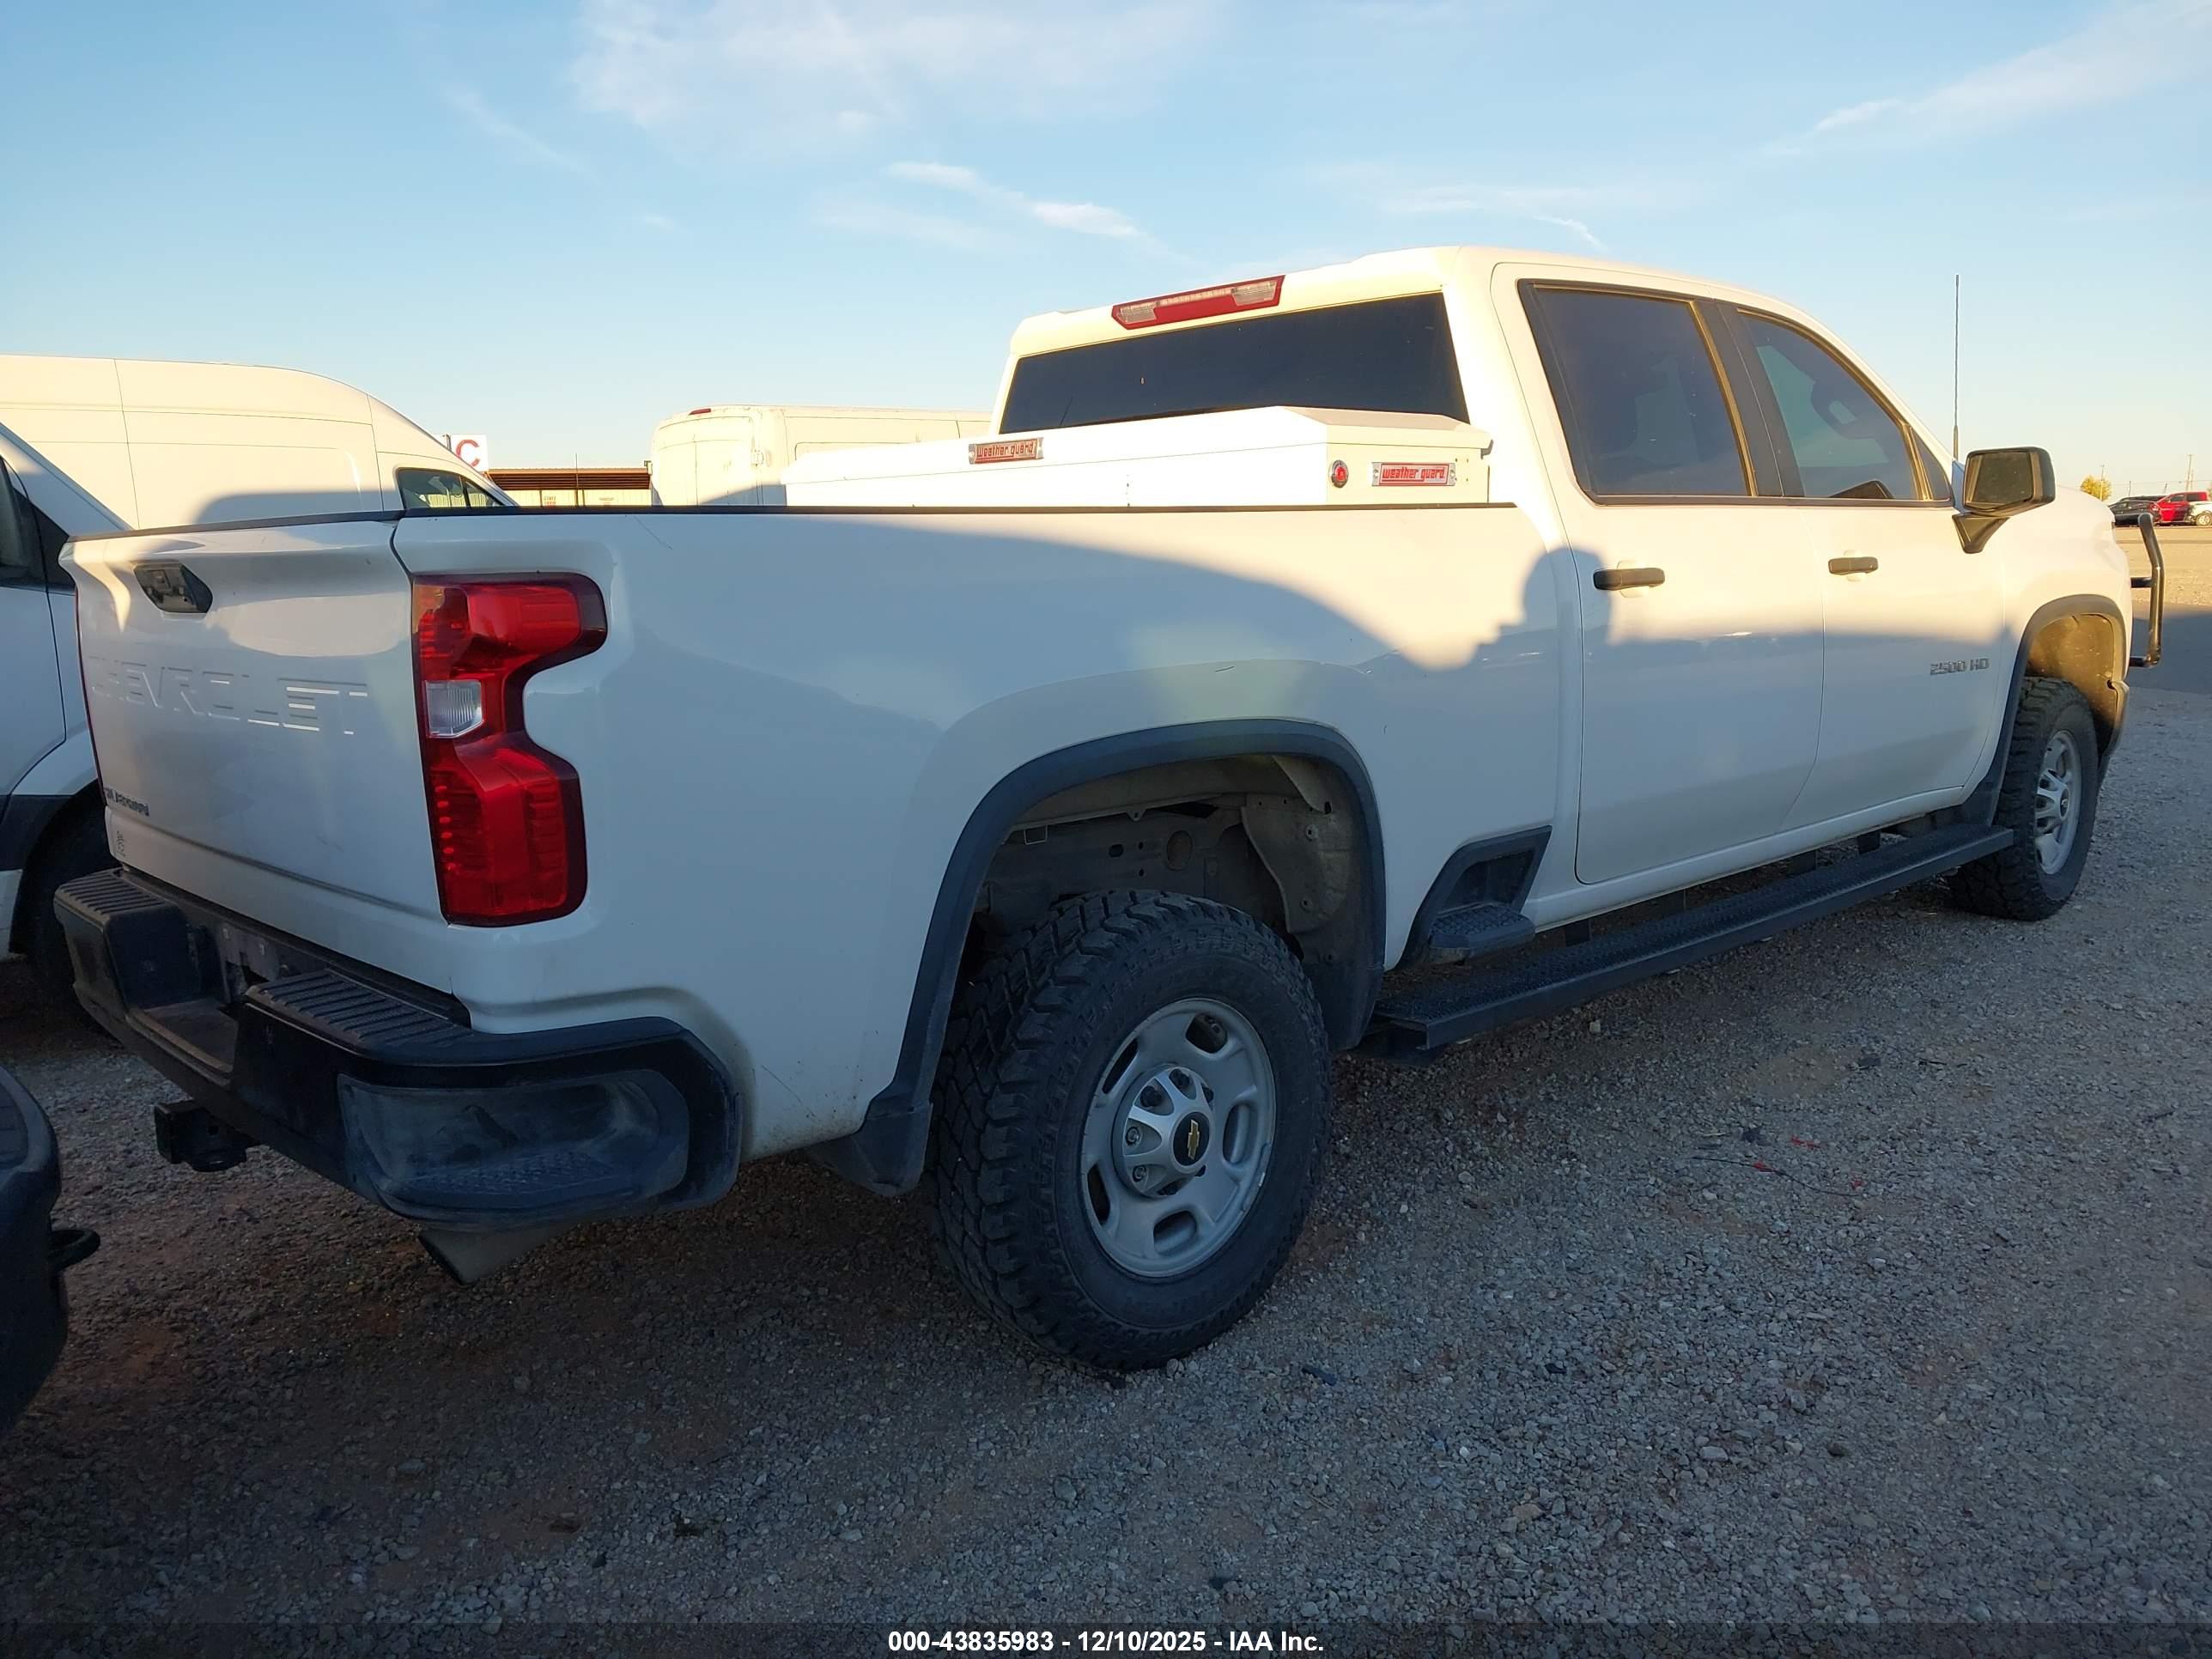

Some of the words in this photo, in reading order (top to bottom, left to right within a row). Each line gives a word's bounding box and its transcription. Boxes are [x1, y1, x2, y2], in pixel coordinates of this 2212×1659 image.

[456, 439, 481, 467] C
[976, 445, 1009, 458] weather
[1010, 441, 1035, 456] guard
[1382, 466, 1419, 479] weather
[1420, 466, 1445, 482] guard
[1970, 658, 1990, 672] HD
